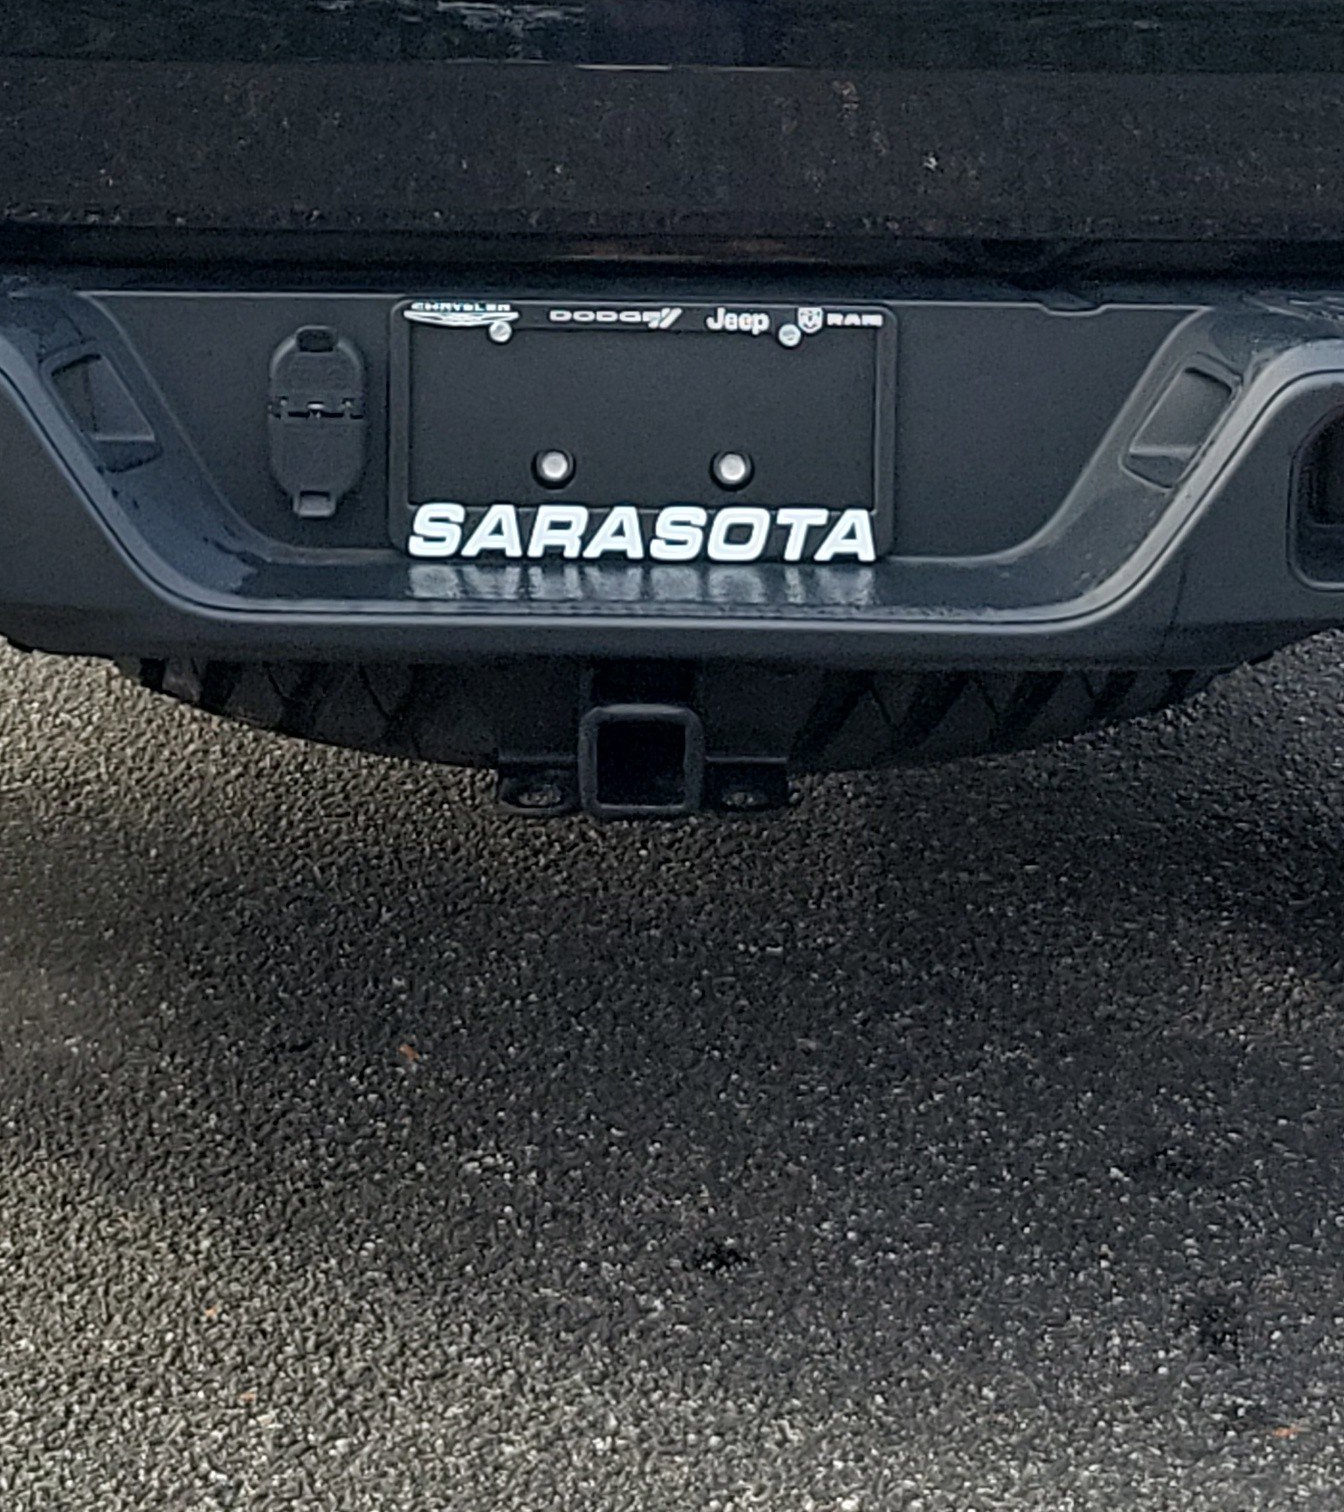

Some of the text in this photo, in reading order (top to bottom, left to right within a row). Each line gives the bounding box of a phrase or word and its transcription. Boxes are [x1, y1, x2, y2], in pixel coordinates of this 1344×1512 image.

[411, 302, 511, 311] CHRYSLER
[706, 307, 769, 335] Jeep
[827, 313, 883, 326] RAM
[408, 502, 877, 561] SARASOTA
